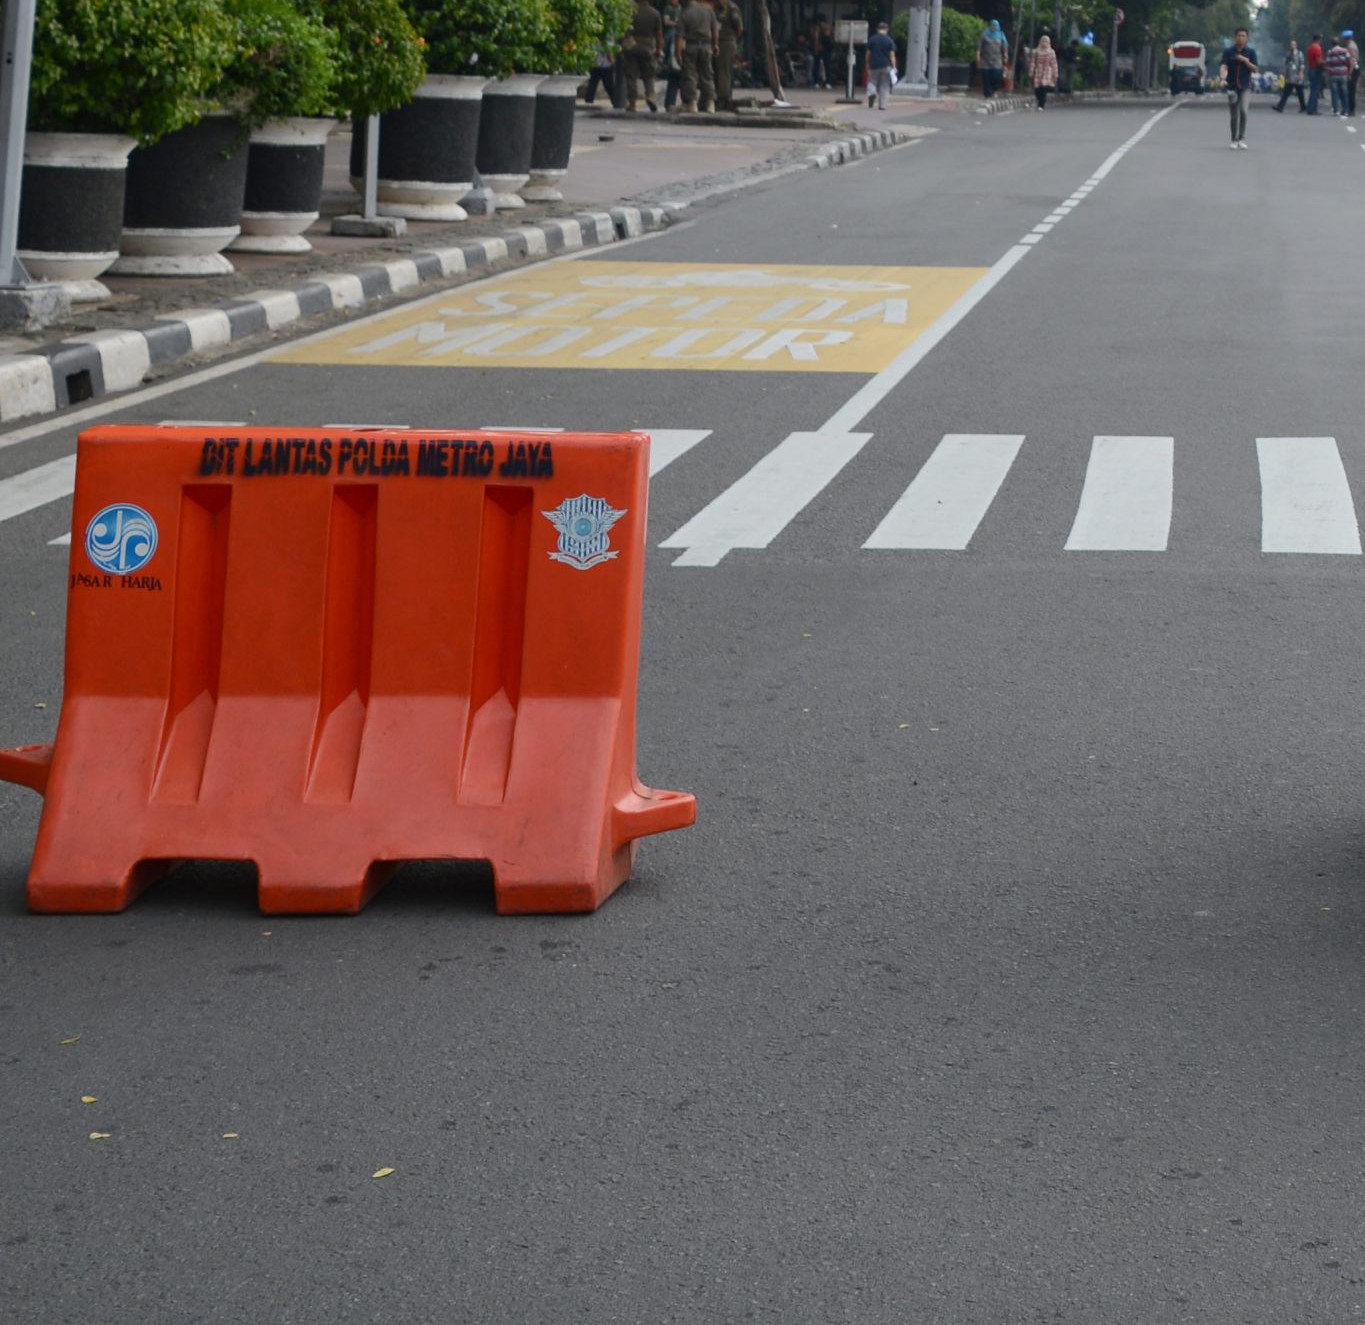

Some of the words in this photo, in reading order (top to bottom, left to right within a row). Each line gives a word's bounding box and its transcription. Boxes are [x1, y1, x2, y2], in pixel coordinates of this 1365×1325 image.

[439, 290, 909, 324] SEPEDA
[345, 321, 855, 362] MOTOR
[201, 437, 240, 475] DIT
[240, 437, 333, 475] LANTAS
[337, 438, 411, 477] POLDA
[416, 439, 494, 478] METRO
[500, 440, 555, 480] JAYA
